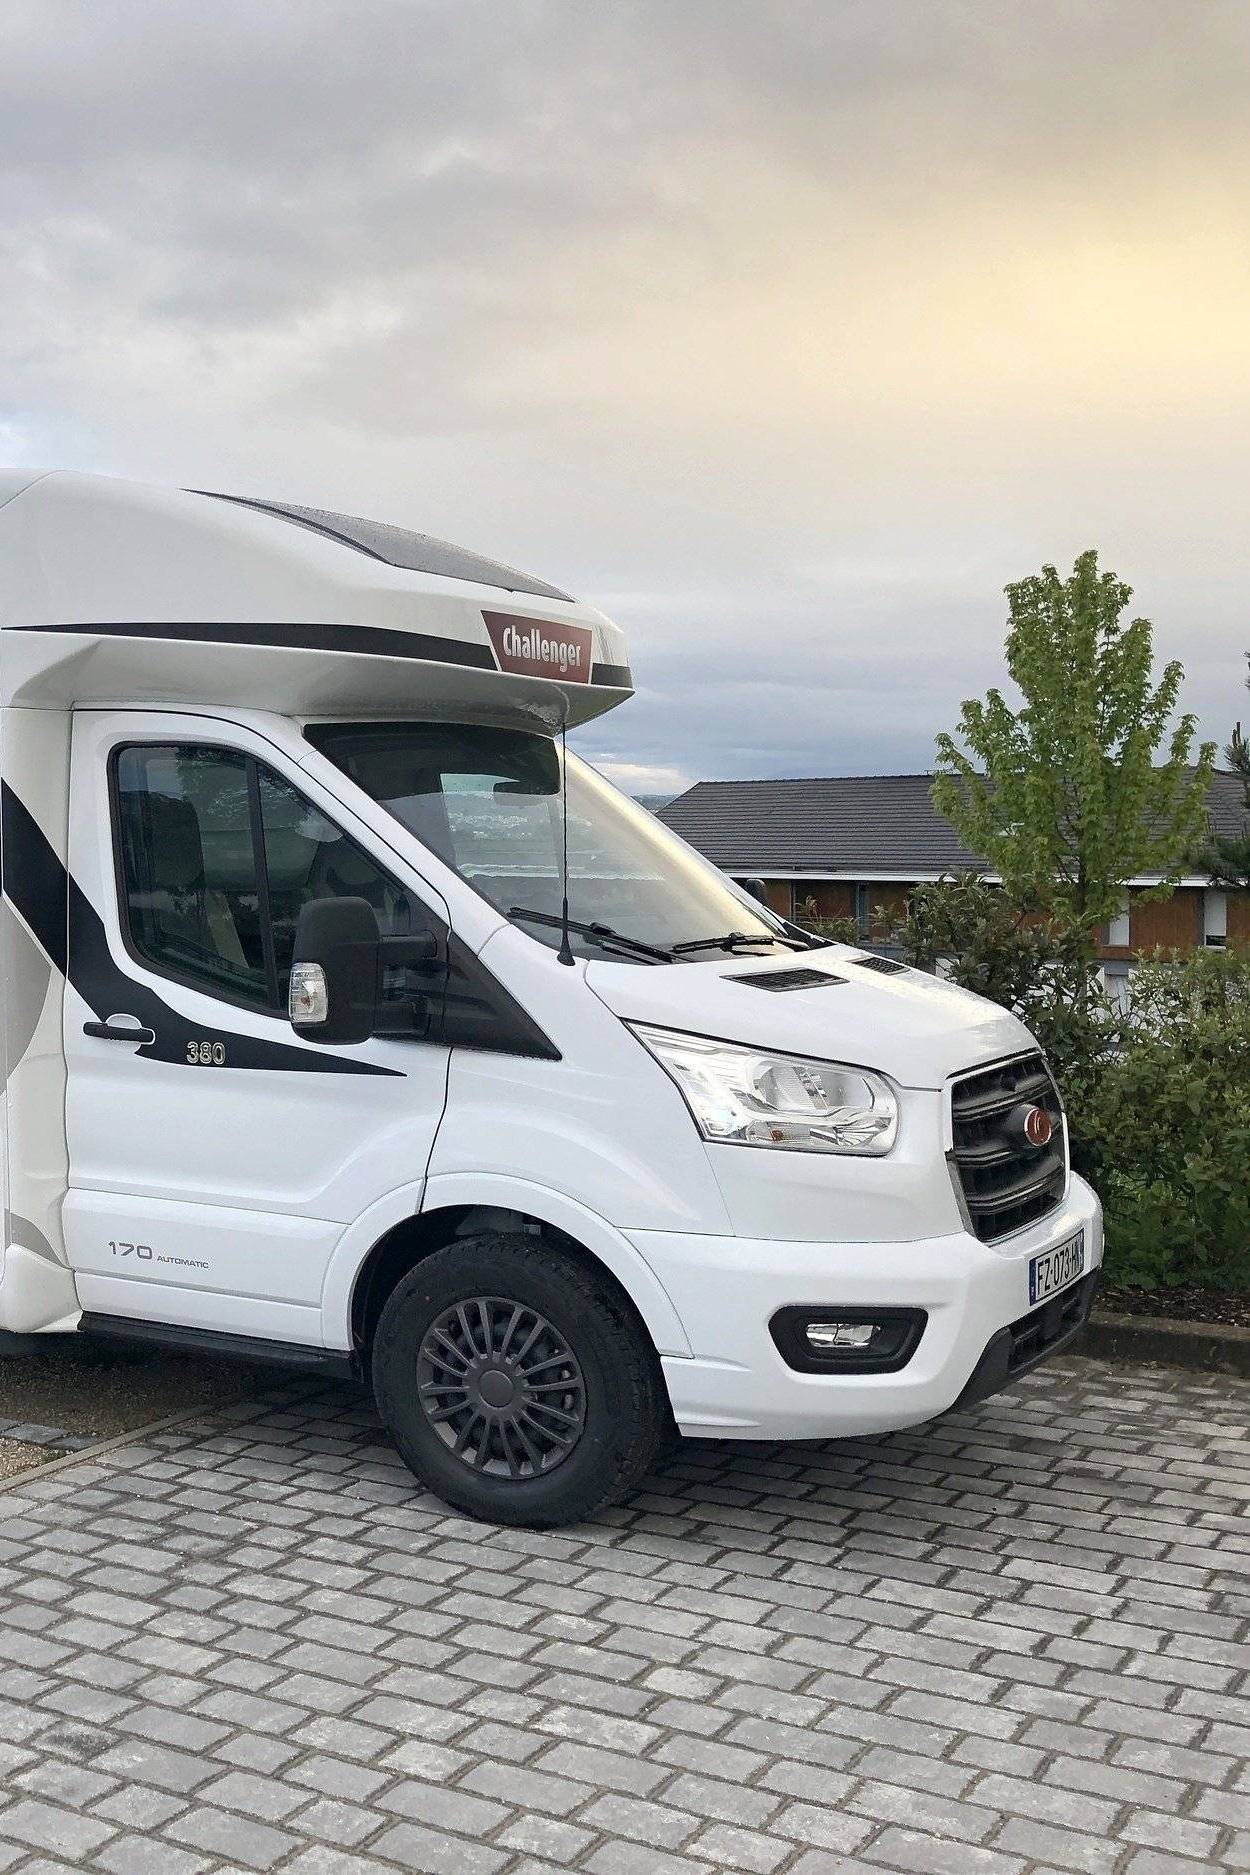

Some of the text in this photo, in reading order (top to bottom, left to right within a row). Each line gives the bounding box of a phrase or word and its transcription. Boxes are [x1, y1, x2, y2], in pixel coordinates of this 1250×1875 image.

[502, 625, 582, 673] Challenger
[186, 1041, 226, 1065] 380
[108, 1241, 210, 1269] 170 AUTOMATIC
